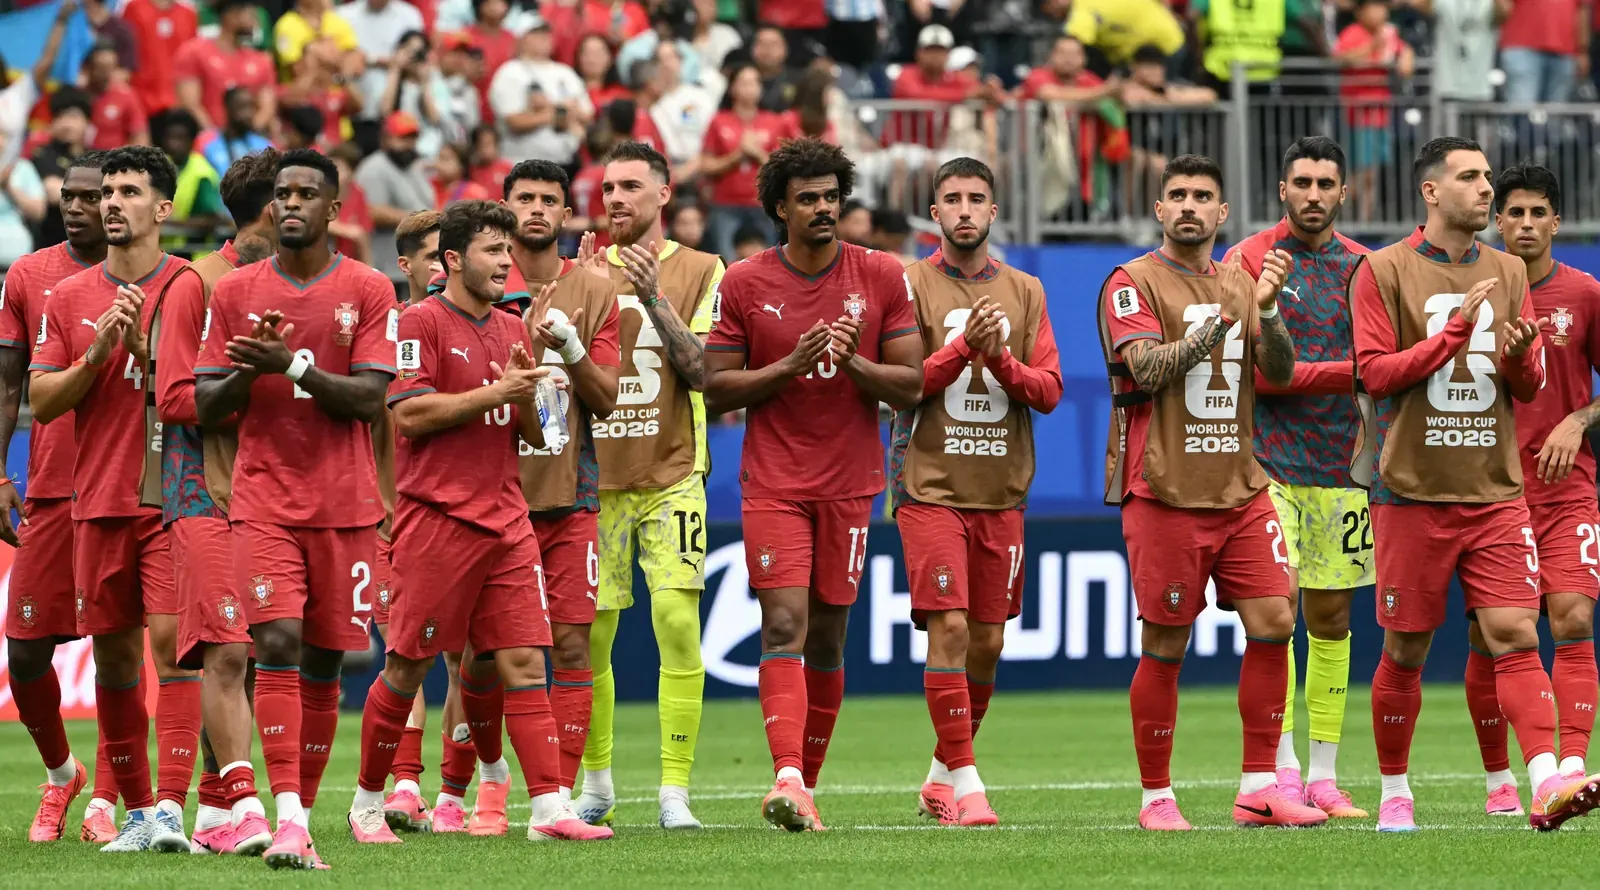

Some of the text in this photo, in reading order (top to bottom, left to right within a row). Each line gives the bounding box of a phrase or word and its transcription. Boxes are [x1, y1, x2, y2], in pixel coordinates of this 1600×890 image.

[124, 352, 143, 389] 4
[620, 383, 643, 394] IFA
[1448, 388, 1479, 401] FIFA
[964, 399, 991, 412] FIFA
[1205, 396, 1234, 408] FIFA
[592, 408, 660, 420] RLD CUP
[1426, 416, 1497, 428] WORLD CUP
[592, 420, 660, 438] 2026
[944, 425, 1008, 438] WORLD CUP
[1185, 423, 1229, 434] WORLD
[944, 438, 1007, 456] 2026
[1185, 436, 1240, 453] 2026
[1425, 429, 1497, 447] 2026
[673, 510, 704, 554] 12
[1342, 507, 1374, 554] 22
[1521, 527, 1539, 573] 5
[1576, 523, 1600, 565] 2
[586, 541, 599, 587] 6
[351, 561, 372, 612] 2
